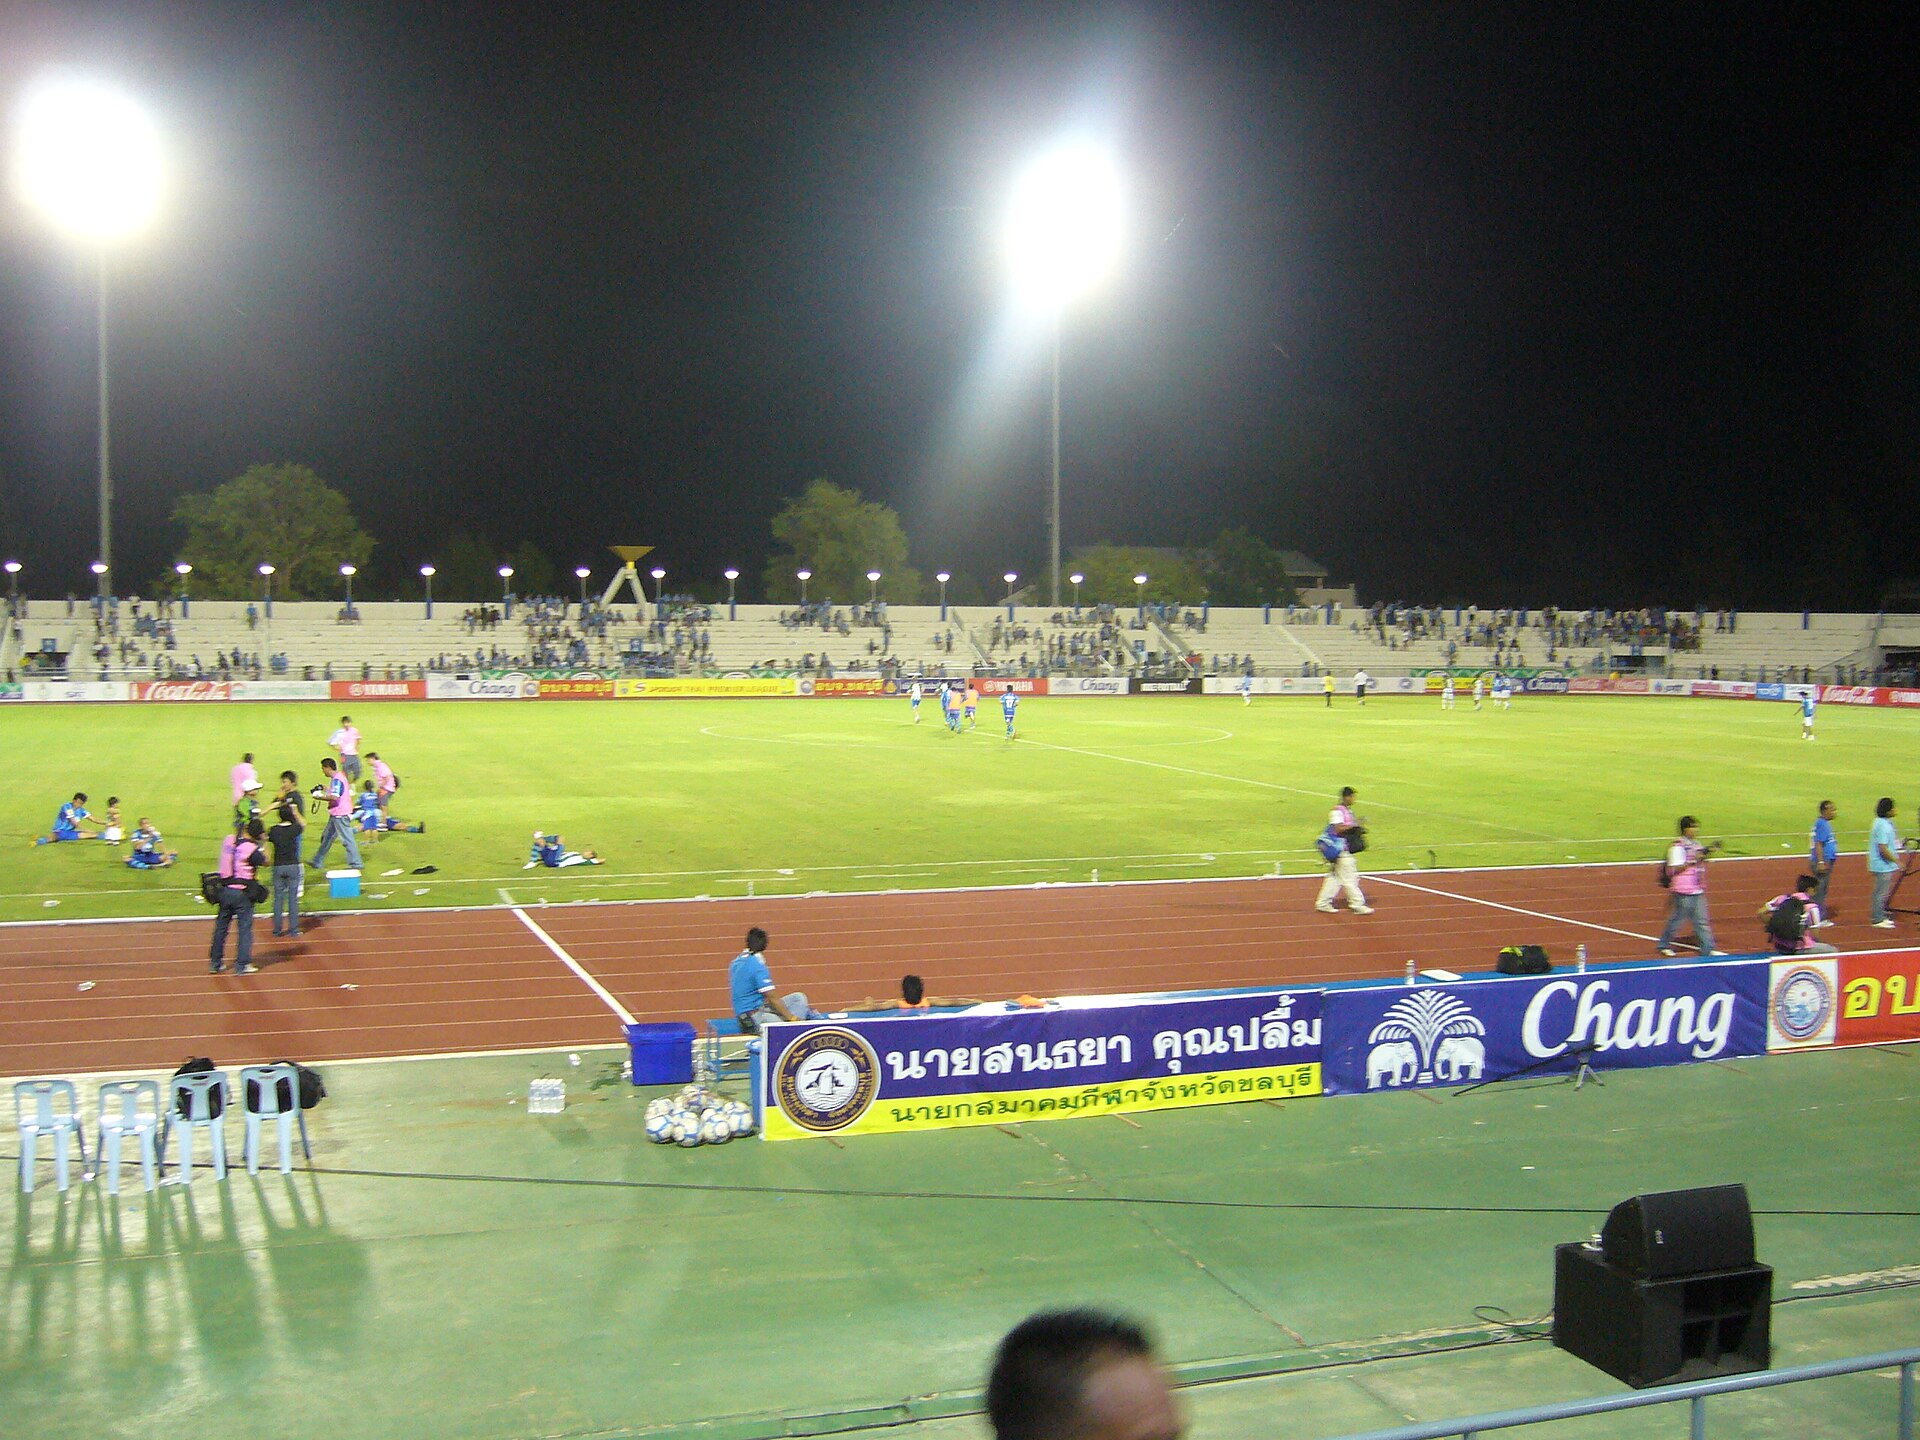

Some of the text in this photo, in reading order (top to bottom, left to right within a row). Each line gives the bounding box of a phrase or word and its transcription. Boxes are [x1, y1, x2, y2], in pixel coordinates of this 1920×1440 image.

[468, 681, 516, 696] Chang
[1080, 678, 1120, 693] Chang
[885, 994, 1322, 1080] นายสนธยา คุณปลื้ม
[1521, 974, 1737, 1059] Chang
[891, 1065, 1313, 1123] นายกสมาคมกีฬาจังหวัดชลบุรี
